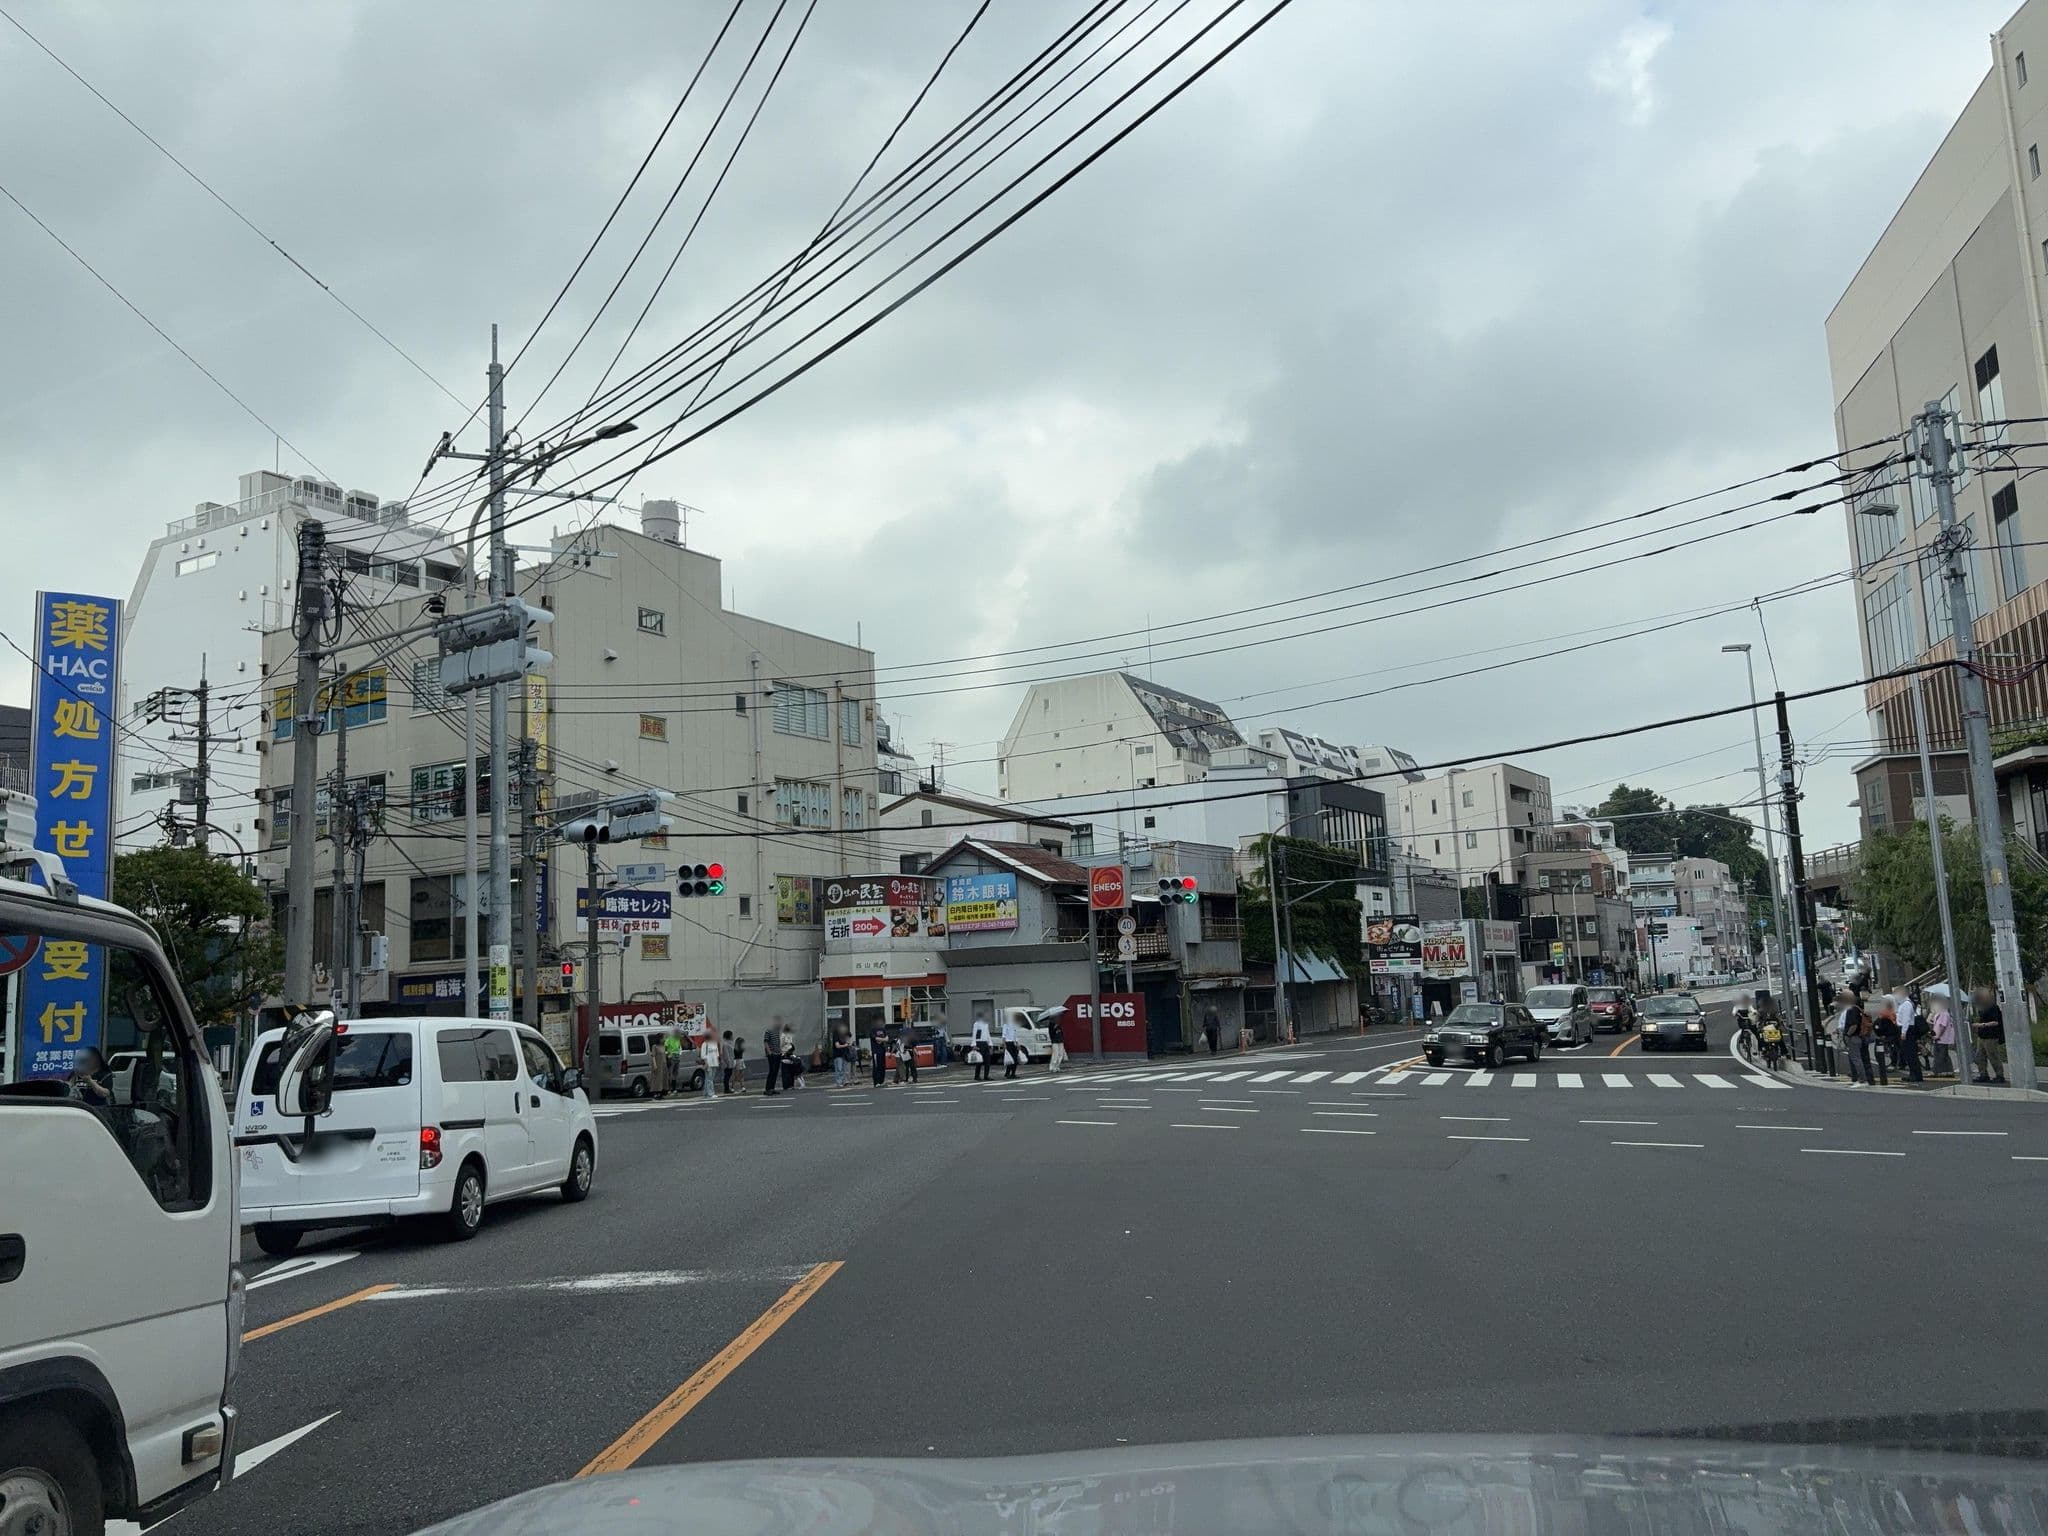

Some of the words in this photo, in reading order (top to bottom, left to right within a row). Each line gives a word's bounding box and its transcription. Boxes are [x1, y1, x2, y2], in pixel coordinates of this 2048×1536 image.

[50, 601, 109, 651] 薬
[48, 655, 107, 679] HAC
[39, 698, 99, 1043] 処方せ受付
[952, 883, 1010, 901] 鈴木眼科
[1093, 882, 1122, 892] ENEOS
[606, 897, 670, 912] 臨海セレクト
[597, 920, 660, 931] 料体受付中
[830, 924, 850, 938] 右折
[854, 923, 879, 931] 200m
[1121, 920, 1132, 929] 40
[1423, 944, 1466, 961] M&M
[36, 1049, 80, 1062] 営業時
